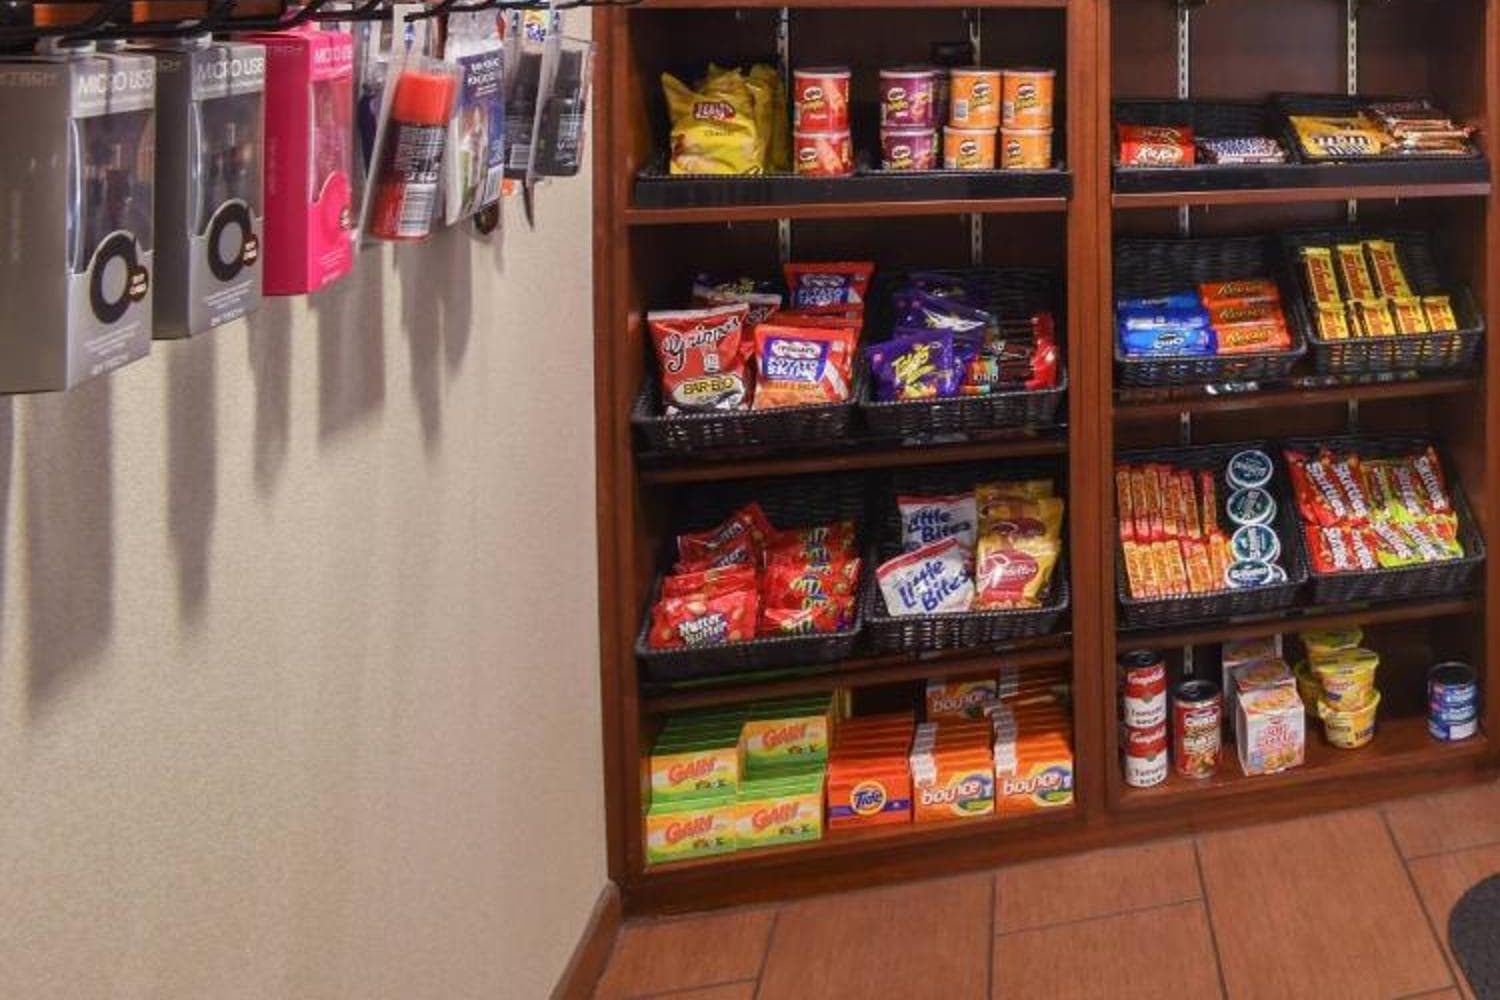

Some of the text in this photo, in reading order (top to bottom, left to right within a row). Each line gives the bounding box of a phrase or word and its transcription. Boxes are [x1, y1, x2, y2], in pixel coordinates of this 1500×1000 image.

[243, 56, 265, 76] USB
[78, 71, 127, 97] MICO
[129, 69, 153, 89] USB
[909, 506, 952, 533] Little
[921, 522, 972, 542] Bites
[921, 568, 971, 611] Bites
[921, 780, 983, 805] bounce
[1003, 773, 1062, 794] bounce
[853, 789, 884, 809] Tide
